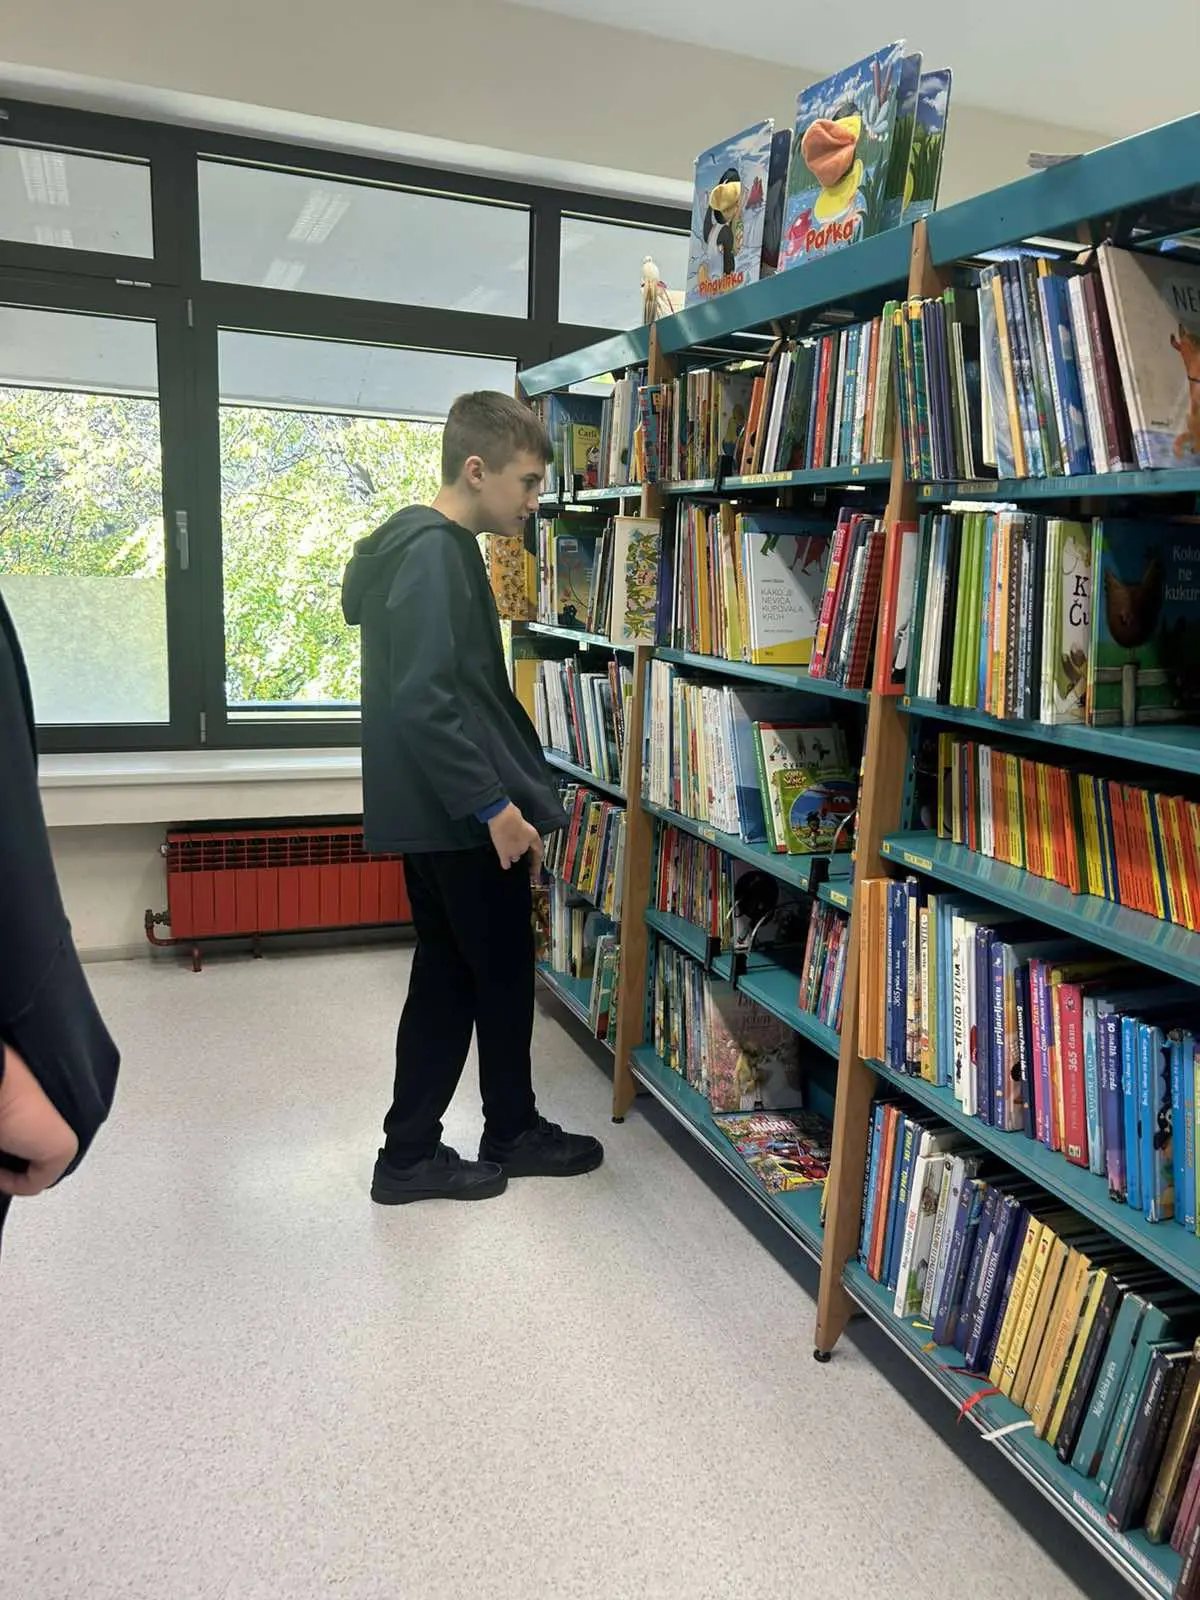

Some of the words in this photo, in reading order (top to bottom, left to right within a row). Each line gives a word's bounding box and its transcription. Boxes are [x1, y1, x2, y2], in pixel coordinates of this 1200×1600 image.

[1172, 284, 1200, 313] NE
[1107, 1022, 1116, 1033] 10
[1068, 1051, 1078, 1072] 365
